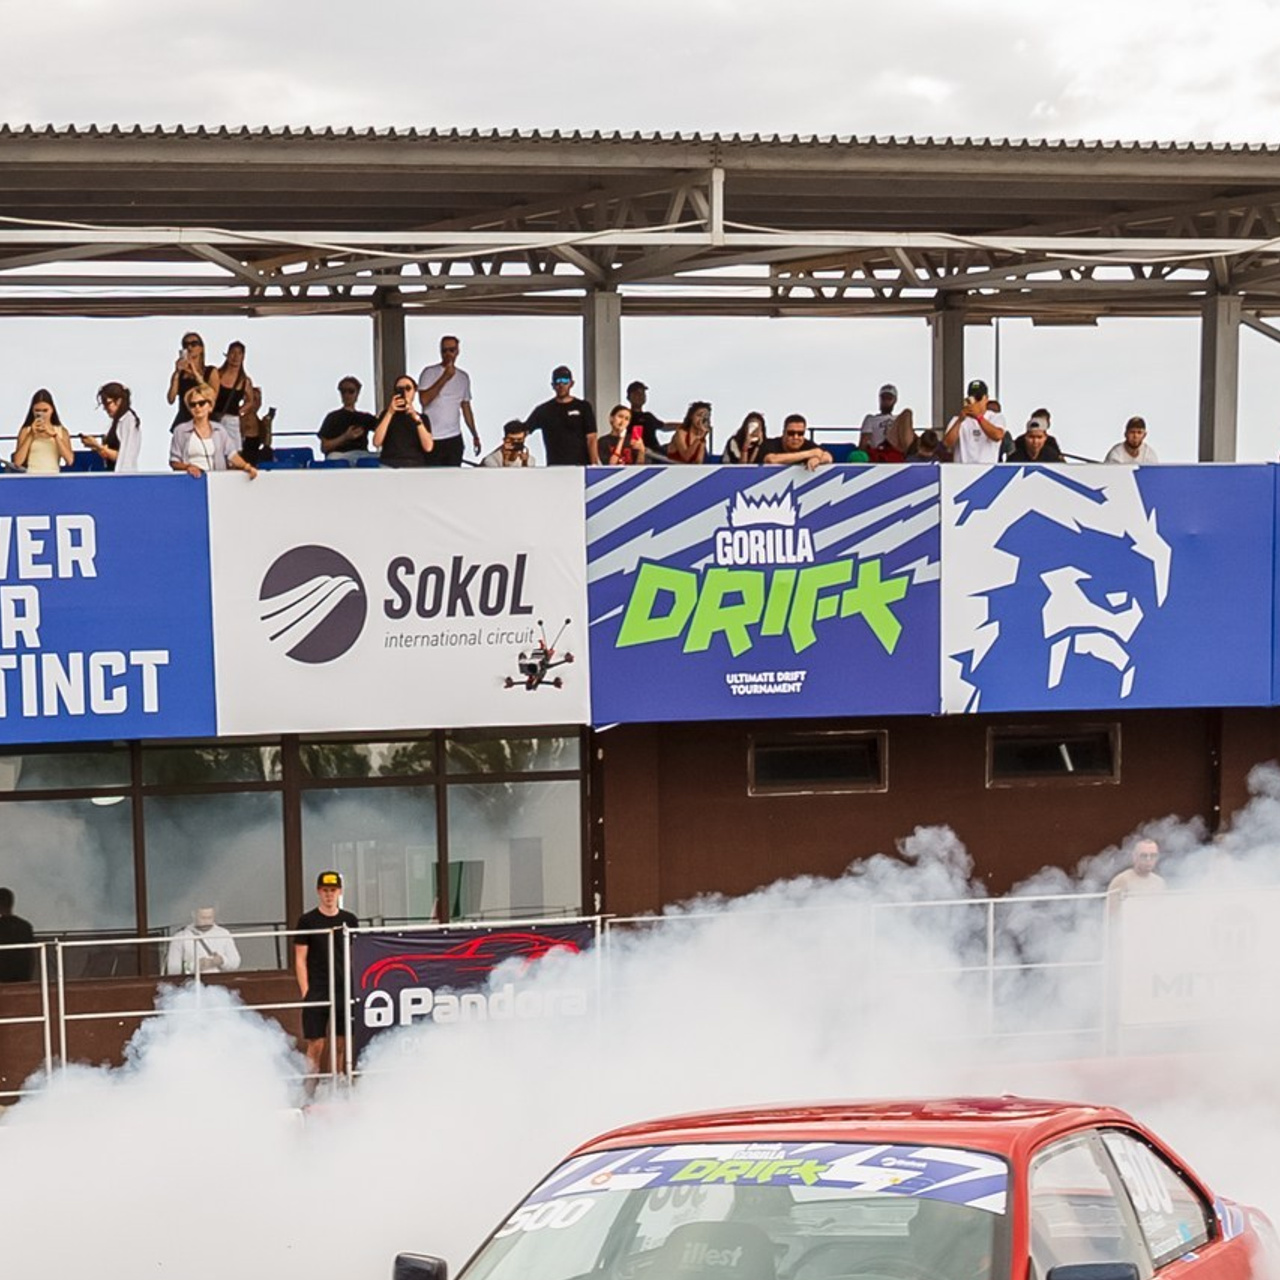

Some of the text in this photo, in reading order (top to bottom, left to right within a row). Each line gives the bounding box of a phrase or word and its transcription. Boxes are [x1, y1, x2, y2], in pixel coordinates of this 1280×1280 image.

[716, 528, 814, 565] GORILLA
[615, 558, 909, 657] DRIFT
[384, 626, 535, 648] international circuit
[726, 671, 807, 684] ULTIMATE DRIFT
[731, 682, 803, 695] TOURNAMENT
[399, 983, 588, 1026] Pandora
[669, 1159, 830, 1186] DRIFT
[495, 1198, 595, 1239] 500
[681, 1242, 743, 1267] illest
